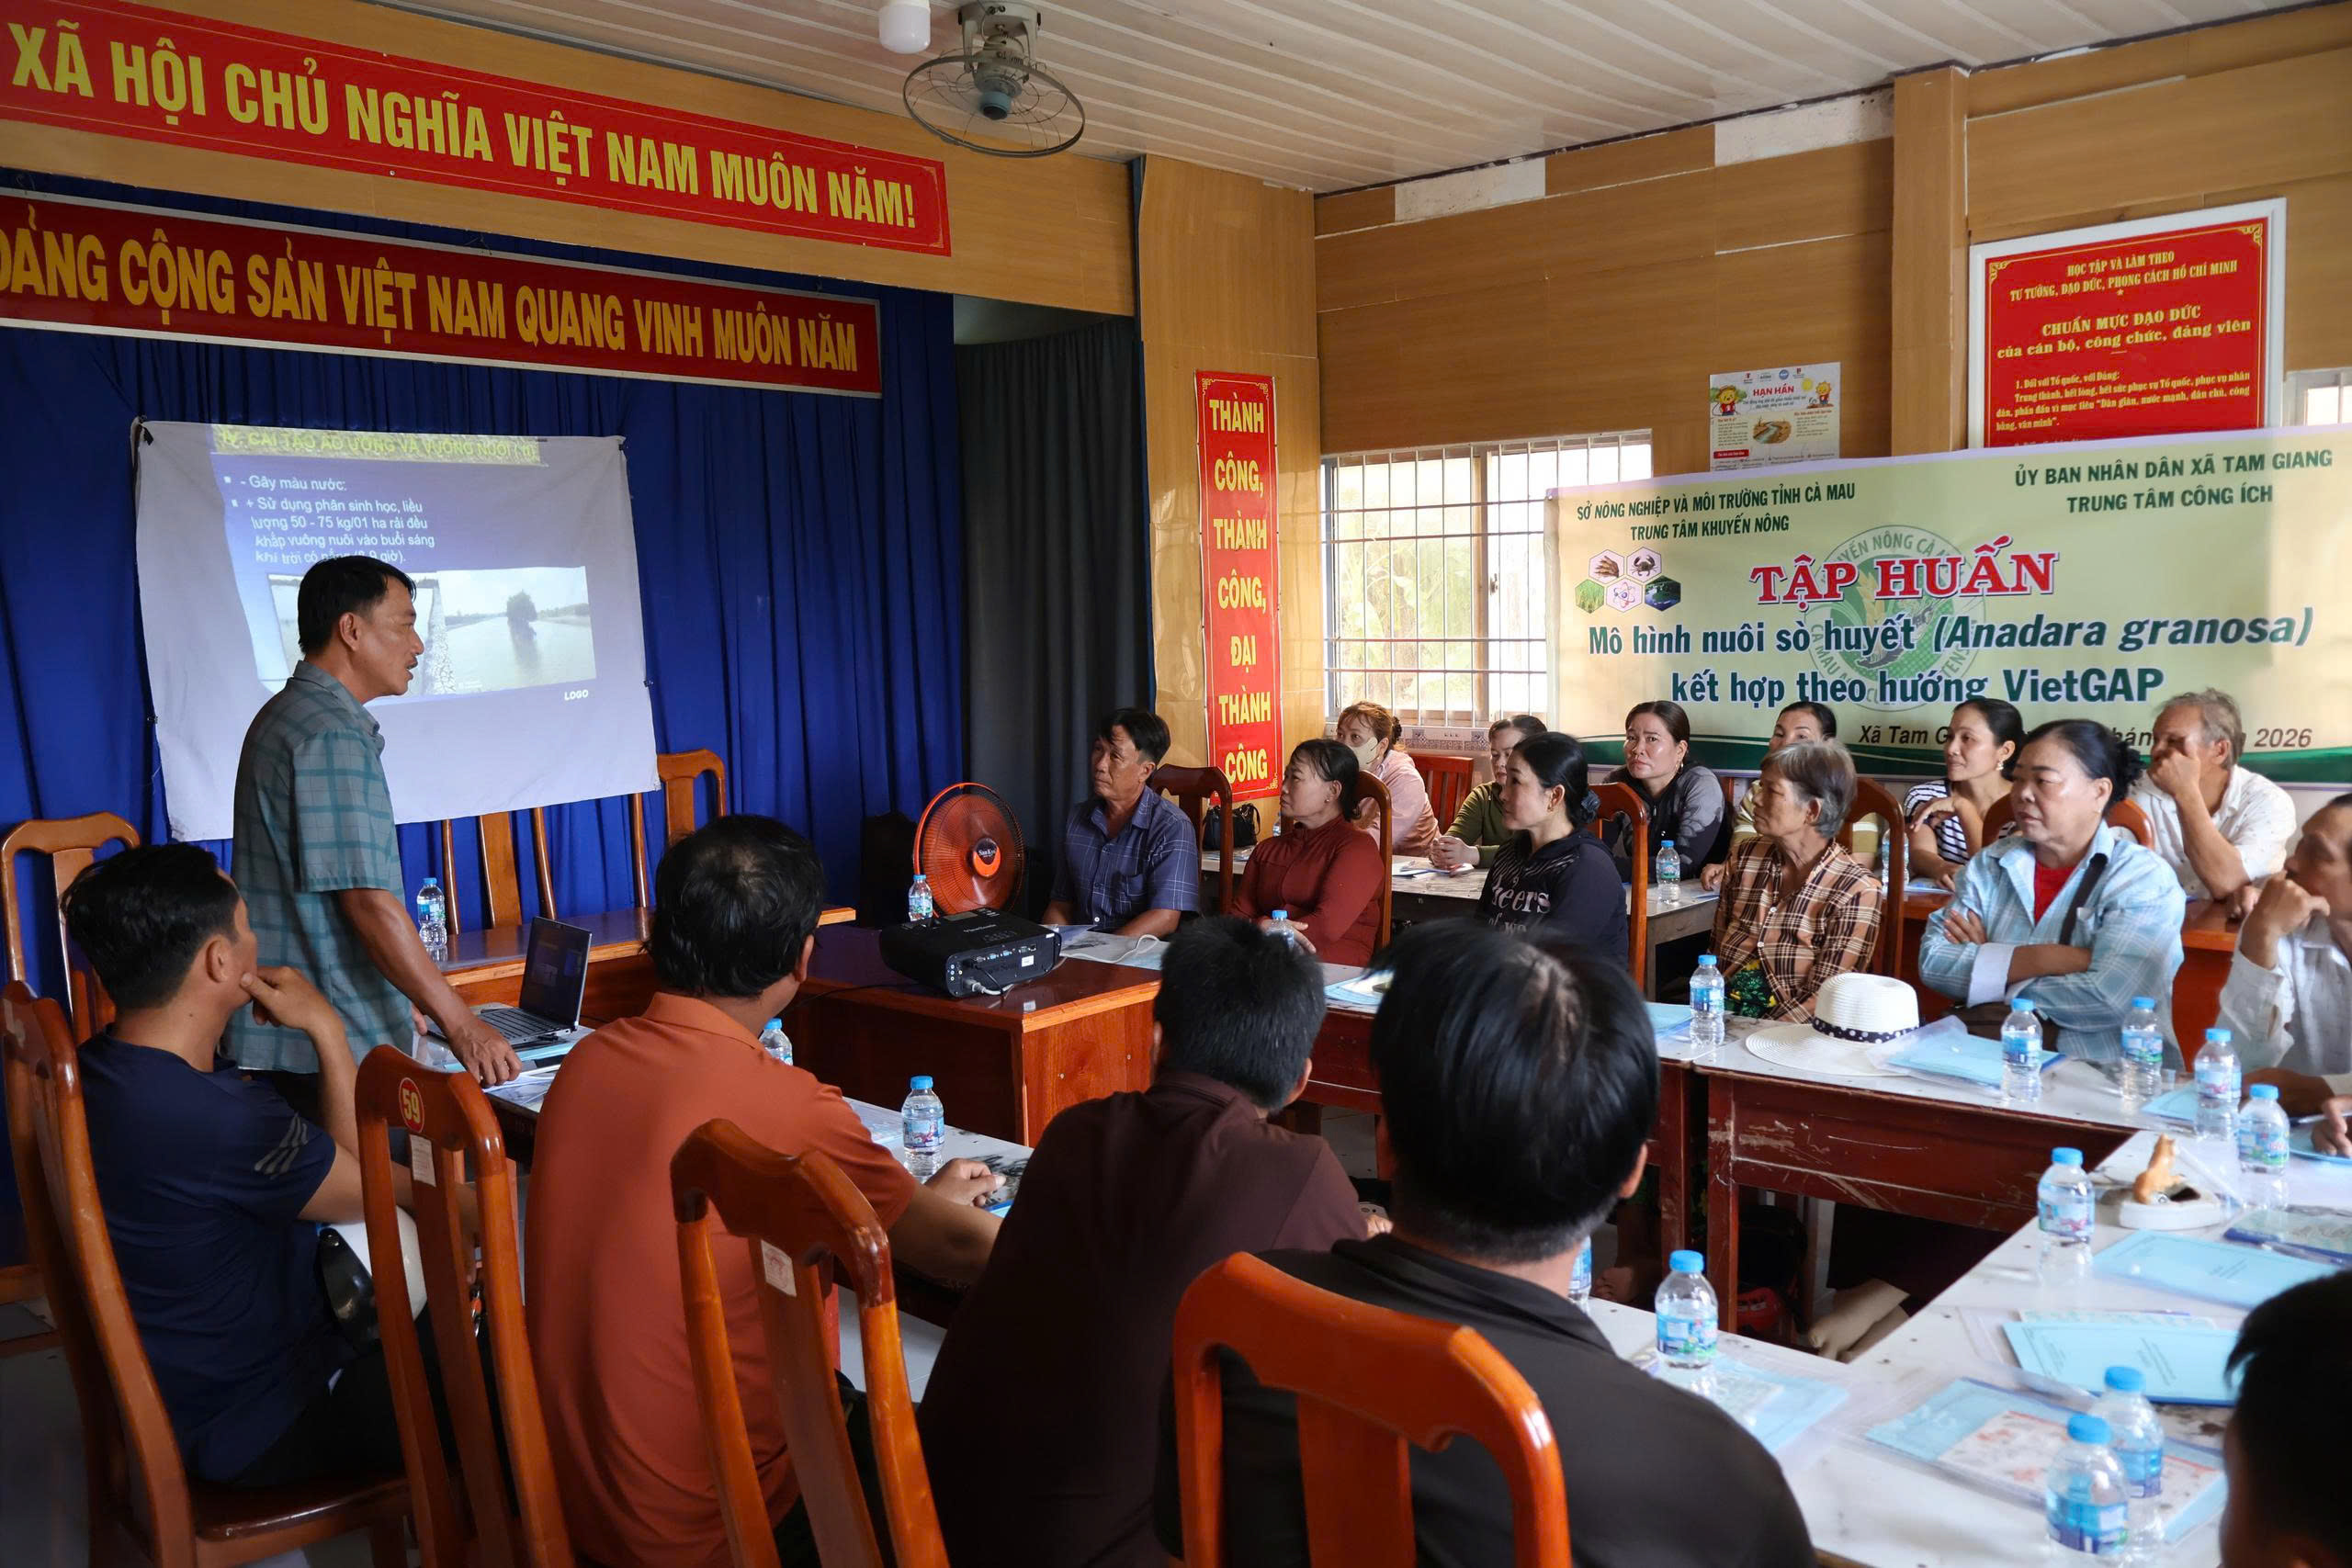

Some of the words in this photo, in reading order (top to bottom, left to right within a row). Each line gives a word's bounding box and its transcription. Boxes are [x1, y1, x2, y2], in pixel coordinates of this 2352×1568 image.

[8, 19, 95, 97] XÃ
[110, 38, 206, 126] HỘI
[224, 58, 329, 135] CHỦ
[345, 85, 493, 162] NGHĨA
[504, 110, 593, 186] VIỆT
[606, 131, 699, 195] NAM
[710, 150, 818, 215] MUÔN
[827, 166, 916, 228] NĂM!
[2067, 264, 2086, 276] HỌC
[2088, 259, 2108, 274] TẬP
[2110, 256, 2122, 270] VÀ
[2125, 254, 2145, 268] LÀM
[2148, 251, 2175, 265] THEO
[2109, 274, 2141, 288] PHONG
[2144, 269, 2169, 284] CÁCH
[2189, 262, 2207, 277] CHÍ
[2210, 260, 2237, 275] MINH
[119, 228, 235, 325] CỘNG
[247, 237, 327, 321] SẢN
[336, 257, 416, 344] VIỆT
[427, 276, 506, 339] NAM
[515, 286, 625, 350] QUANG
[633, 299, 704, 357] VINH
[712, 300, 792, 366] MUÔN
[799, 312, 857, 371] NĂM
[2027, 343, 2053, 355] cán
[2086, 334, 2121, 349] công
[2217, 320, 2251, 333] viên
[2097, 314, 2129, 331] MỰC
[1209, 392, 1264, 433] THÀNH
[249, 475, 276, 491] Gây
[279, 477, 307, 490] màu
[1215, 453, 1263, 497] CÔNG,
[2016, 464, 2039, 487] ỦY
[2045, 467, 2083, 485] BAN
[2087, 460, 2138, 483] NHÂN
[2145, 456, 2184, 479] DÂN
[2190, 453, 2215, 476] XÃ
[2223, 453, 2266, 473] TAM
[2271, 448, 2333, 469] GIANG
[280, 500, 312, 513] dụng
[315, 499, 345, 513] phân
[348, 500, 373, 512] sinh
[375, 500, 401, 513] học,
[402, 498, 423, 513] liều
[1577, 502, 1593, 521] SỞ
[1595, 499, 1624, 519] NÔNG
[1629, 496, 1670, 518] NGHIỆP
[1674, 493, 1689, 513] VÀ
[1692, 491, 1714, 512] MÔI
[1719, 487, 1768, 509] TRƯỜNG
[1771, 483, 1801, 505] TỈNH
[1804, 483, 1822, 502] CÀ
[1826, 482, 1855, 501] MAU
[2067, 494, 2127, 513] TRUNG
[2135, 487, 2174, 509] TÂM
[2180, 483, 2233, 506] CÔNG
[2240, 480, 2273, 503] ÍCH
[251, 516, 288, 530] lượng
[290, 516, 306, 528] 50
[318, 516, 333, 528] 75
[336, 517, 368, 531] kg/01
[371, 517, 387, 529] ha
[407, 513, 427, 529] đều
[1214, 511, 1267, 549] THÀNH
[1630, 524, 1669, 541] TRUNG
[1672, 519, 1698, 538] TÂM
[1702, 513, 1751, 536] KHUYẾN
[1755, 513, 1789, 533] NÔNG
[255, 551, 277, 563] khi
[281, 551, 301, 565] trời
[306, 550, 319, 563] có
[289, 534, 325, 548] vuông
[329, 534, 354, 546] nuôi
[357, 535, 378, 546] vào
[381, 532, 404, 546] buổi
[408, 535, 435, 547] sáng
[1217, 570, 1266, 613] CÔNG,
[1750, 553, 1859, 613] TẬP
[1874, 535, 2059, 601] HUẤN
[1589, 626, 1623, 655] Mô
[1633, 624, 1691, 654] hình
[1702, 621, 1764, 653] nuôi
[1776, 620, 1810, 651] sò
[1824, 614, 1915, 657] huyết
[1934, 614, 2107, 652] (Anadara
[2118, 606, 2313, 651] granosa)
[1230, 636, 1256, 672] ĐẠI
[565, 689, 588, 701] LOGO
[1218, 683, 1271, 725] THÀNH
[1672, 669, 1719, 703] kết
[1730, 671, 1784, 707] hợp
[1796, 671, 1866, 703] theo
[1879, 671, 1988, 703] hướng
[2004, 669, 2165, 704] VietGAP
[1859, 726, 1881, 744] Xã
[1889, 726, 1928, 744] Tam
[2255, 728, 2312, 748] 2026
[1225, 742, 1268, 784] CÔNG
[402, 1088, 421, 1123] 59
